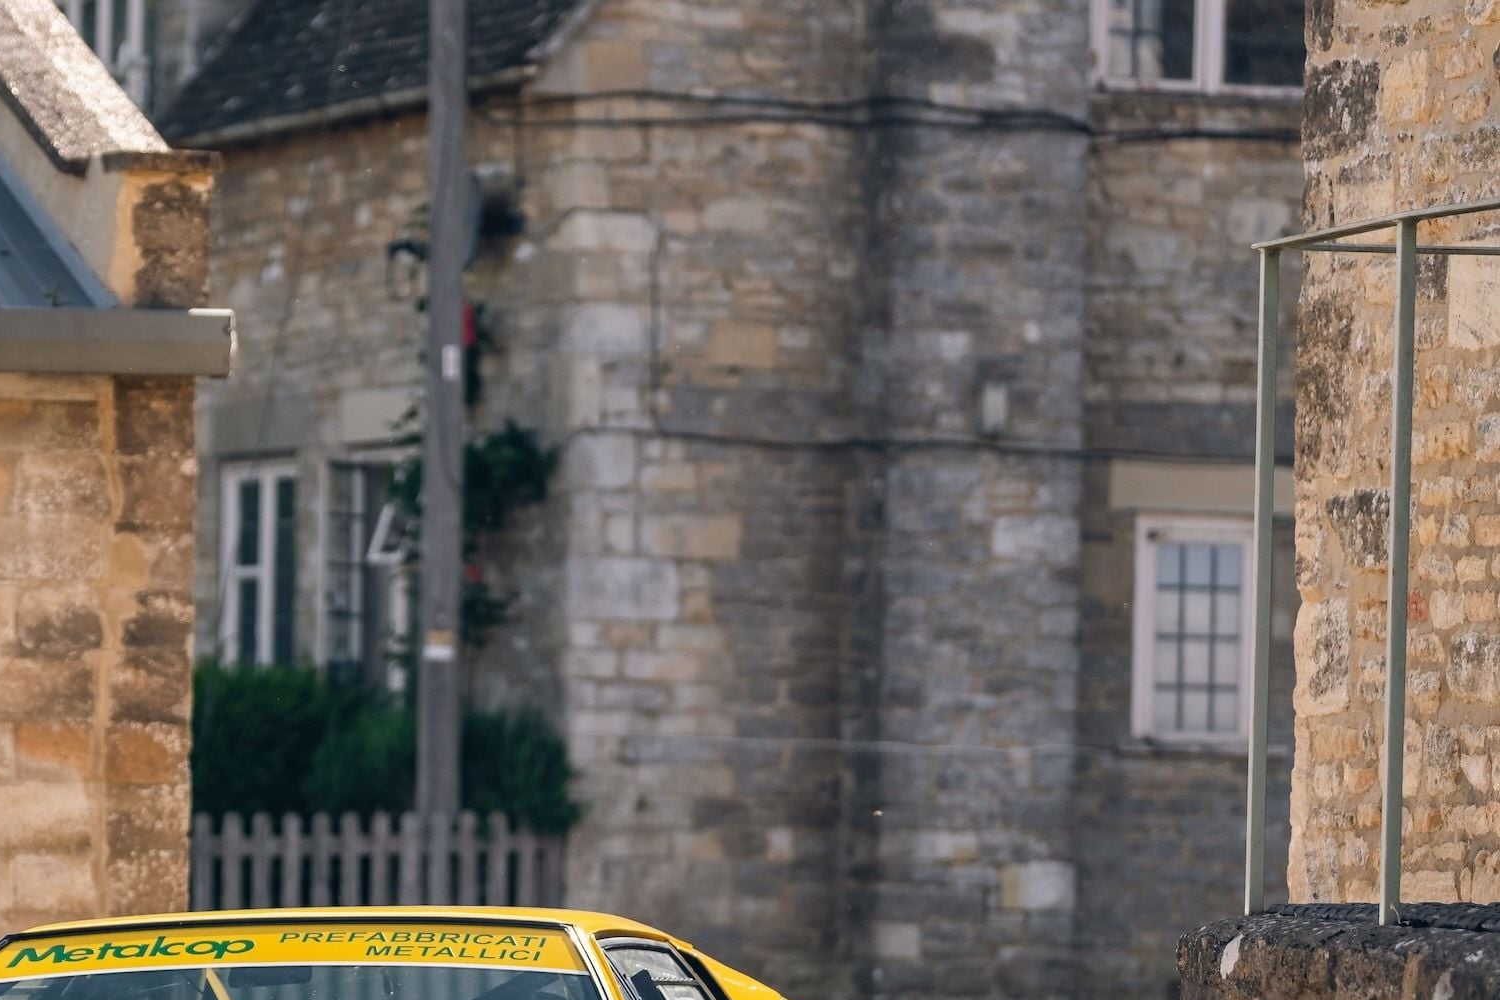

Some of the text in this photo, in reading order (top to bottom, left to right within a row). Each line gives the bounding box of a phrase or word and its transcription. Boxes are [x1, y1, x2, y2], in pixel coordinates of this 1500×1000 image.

[279, 931, 547, 947] PREFABBRICATI
[6, 936, 255, 968] Metalcop
[365, 945, 541, 961] METALLICI
